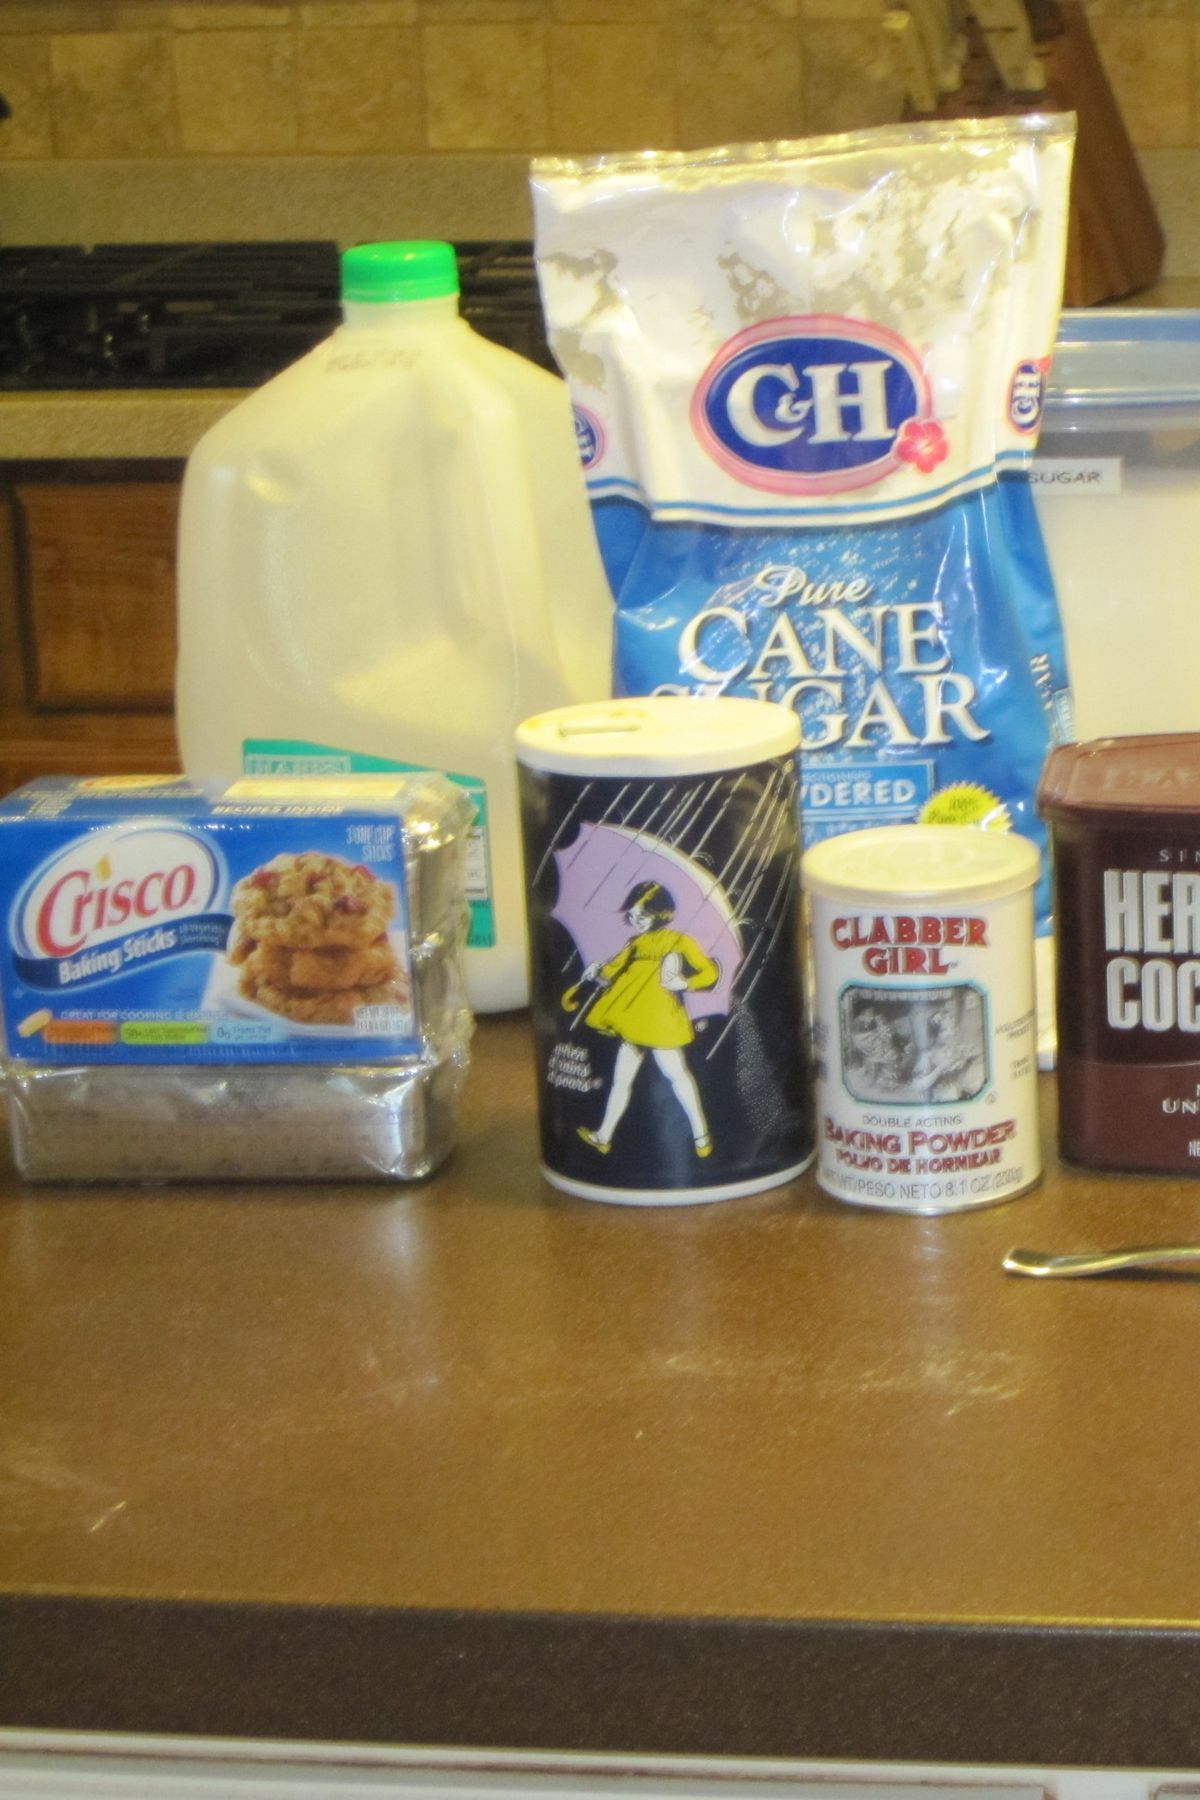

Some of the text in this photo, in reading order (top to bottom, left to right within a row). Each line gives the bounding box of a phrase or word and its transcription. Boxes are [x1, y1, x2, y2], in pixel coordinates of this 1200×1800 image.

[727, 361, 896, 447] C&H
[1029, 471, 1101, 484] SUGAR
[754, 564, 875, 608] Pure
[678, 600, 953, 683] CANE
[651, 672, 991, 752] GAR
[36, 863, 196, 958] Crisco
[830, 915, 990, 950] CLABBER
[58, 947, 124, 985] Baking
[123, 926, 179, 962] Sticks
[862, 946, 949, 976] GIRL
[824, 1115, 1017, 1155] BAKING POWDER
[862, 1114, 963, 1128] DOUBLE ACTING
[886, 1157, 911, 1174] DE
[899, 1182, 943, 1199] NETO
[970, 1173, 992, 1192] OZ
